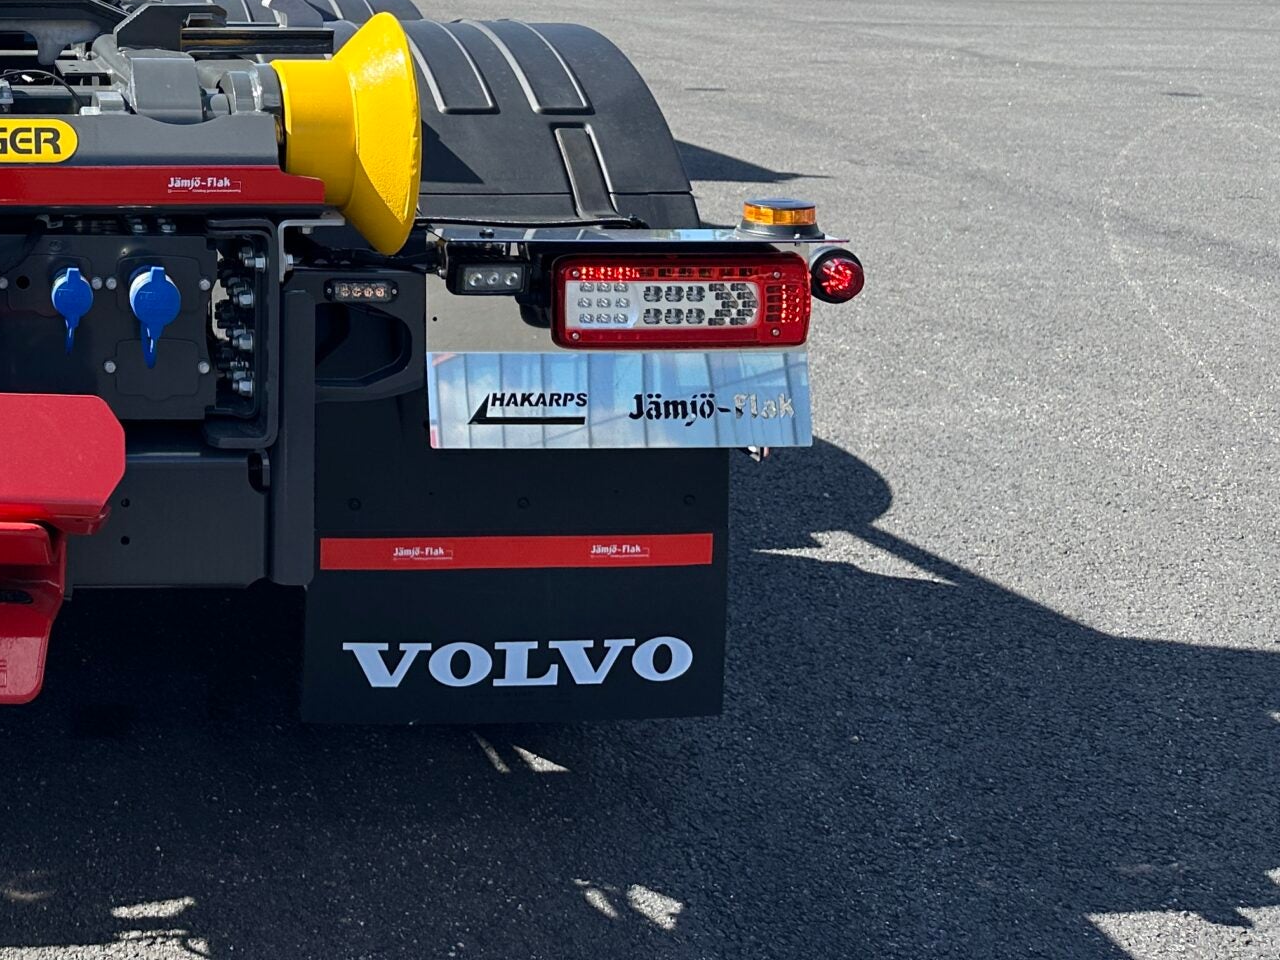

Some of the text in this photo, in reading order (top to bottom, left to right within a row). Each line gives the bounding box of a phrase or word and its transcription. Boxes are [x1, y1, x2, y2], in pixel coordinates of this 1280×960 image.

[167, 177, 231, 190] Jämjö-Flak
[490, 392, 588, 407] HAKARPS
[628, 393, 796, 427] Jämjö-Flak
[393, 546, 444, 557] Jämjö-Flak
[590, 544, 641, 555] Jämjö-Flak
[342, 636, 693, 688] VOLVO
